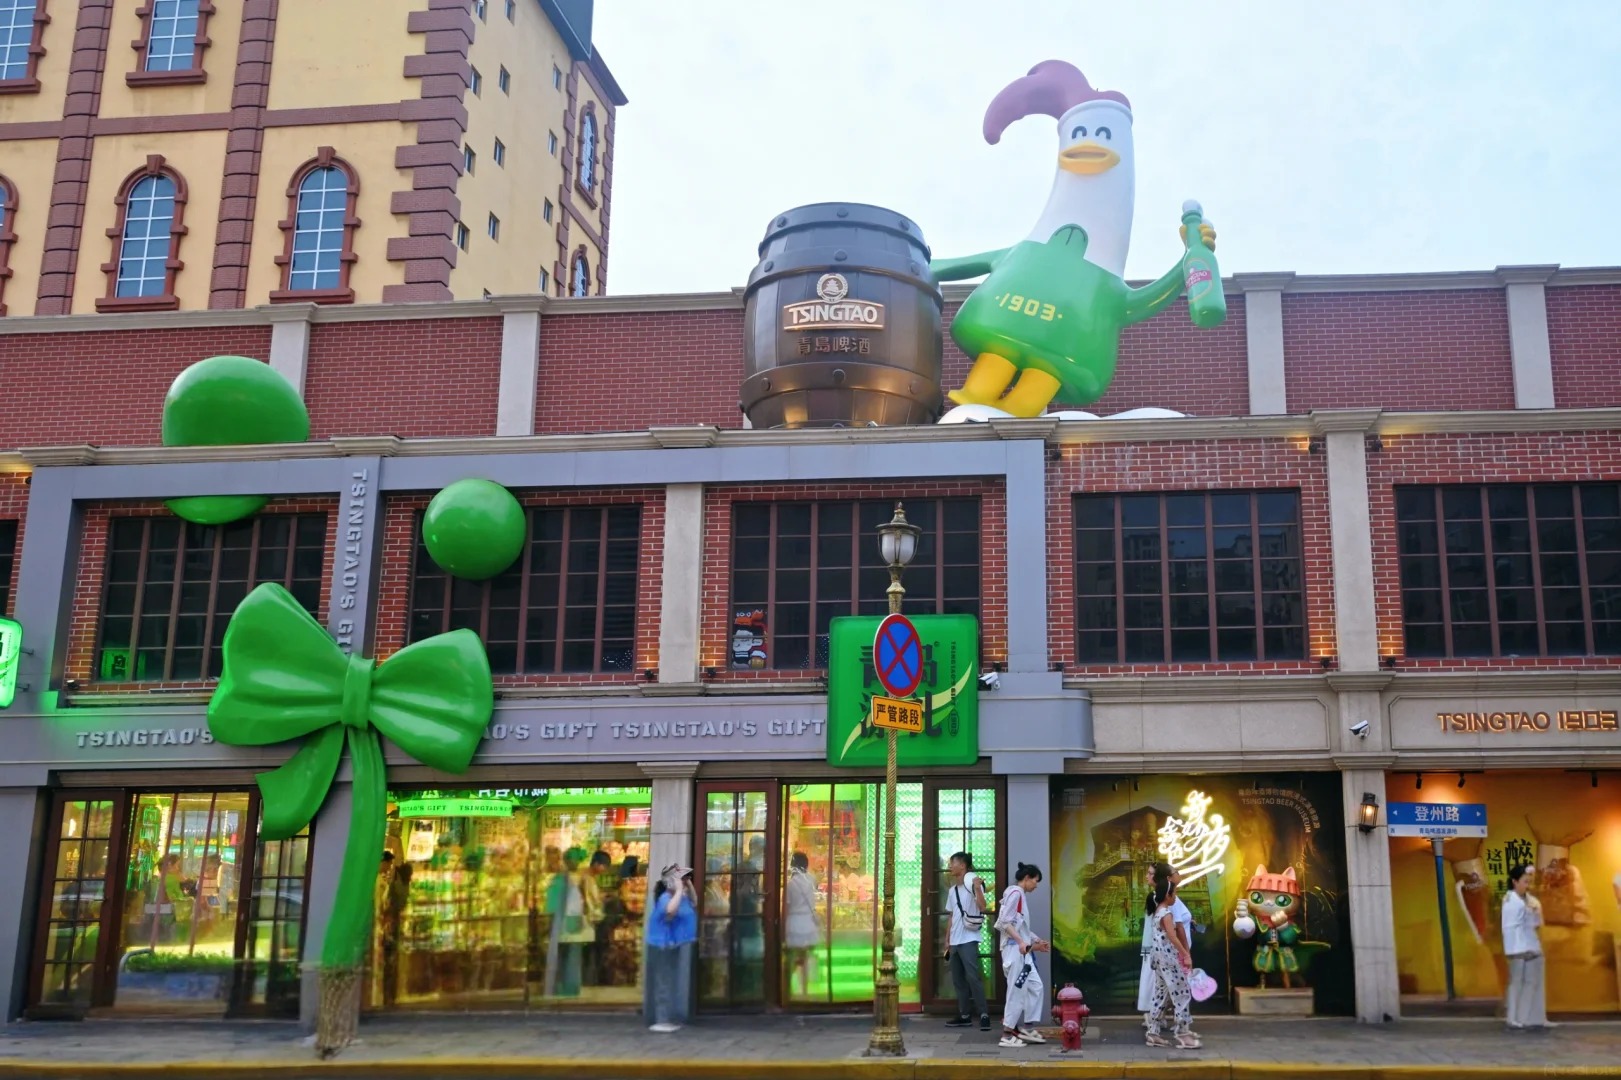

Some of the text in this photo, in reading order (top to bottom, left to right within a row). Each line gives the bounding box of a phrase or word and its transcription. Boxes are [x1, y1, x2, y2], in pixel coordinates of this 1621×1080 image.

[788, 304, 878, 324] TSINGTAO
[340, 468, 367, 609] TSINGTAO'S
[875, 703, 920, 726] 严管路段
[1436, 710, 1620, 732] TSINGTAO 1903
[76, 728, 215, 747] TSINGTAO'S
[540, 722, 598, 739] GIFT
[610, 719, 757, 739] TSINGTAO'S
[767, 718, 826, 736] GIFT
[1276, 798, 1294, 807] BEER
[1294, 804, 1312, 833] MUSEUM
[1414, 806, 1460, 822] 登州路
